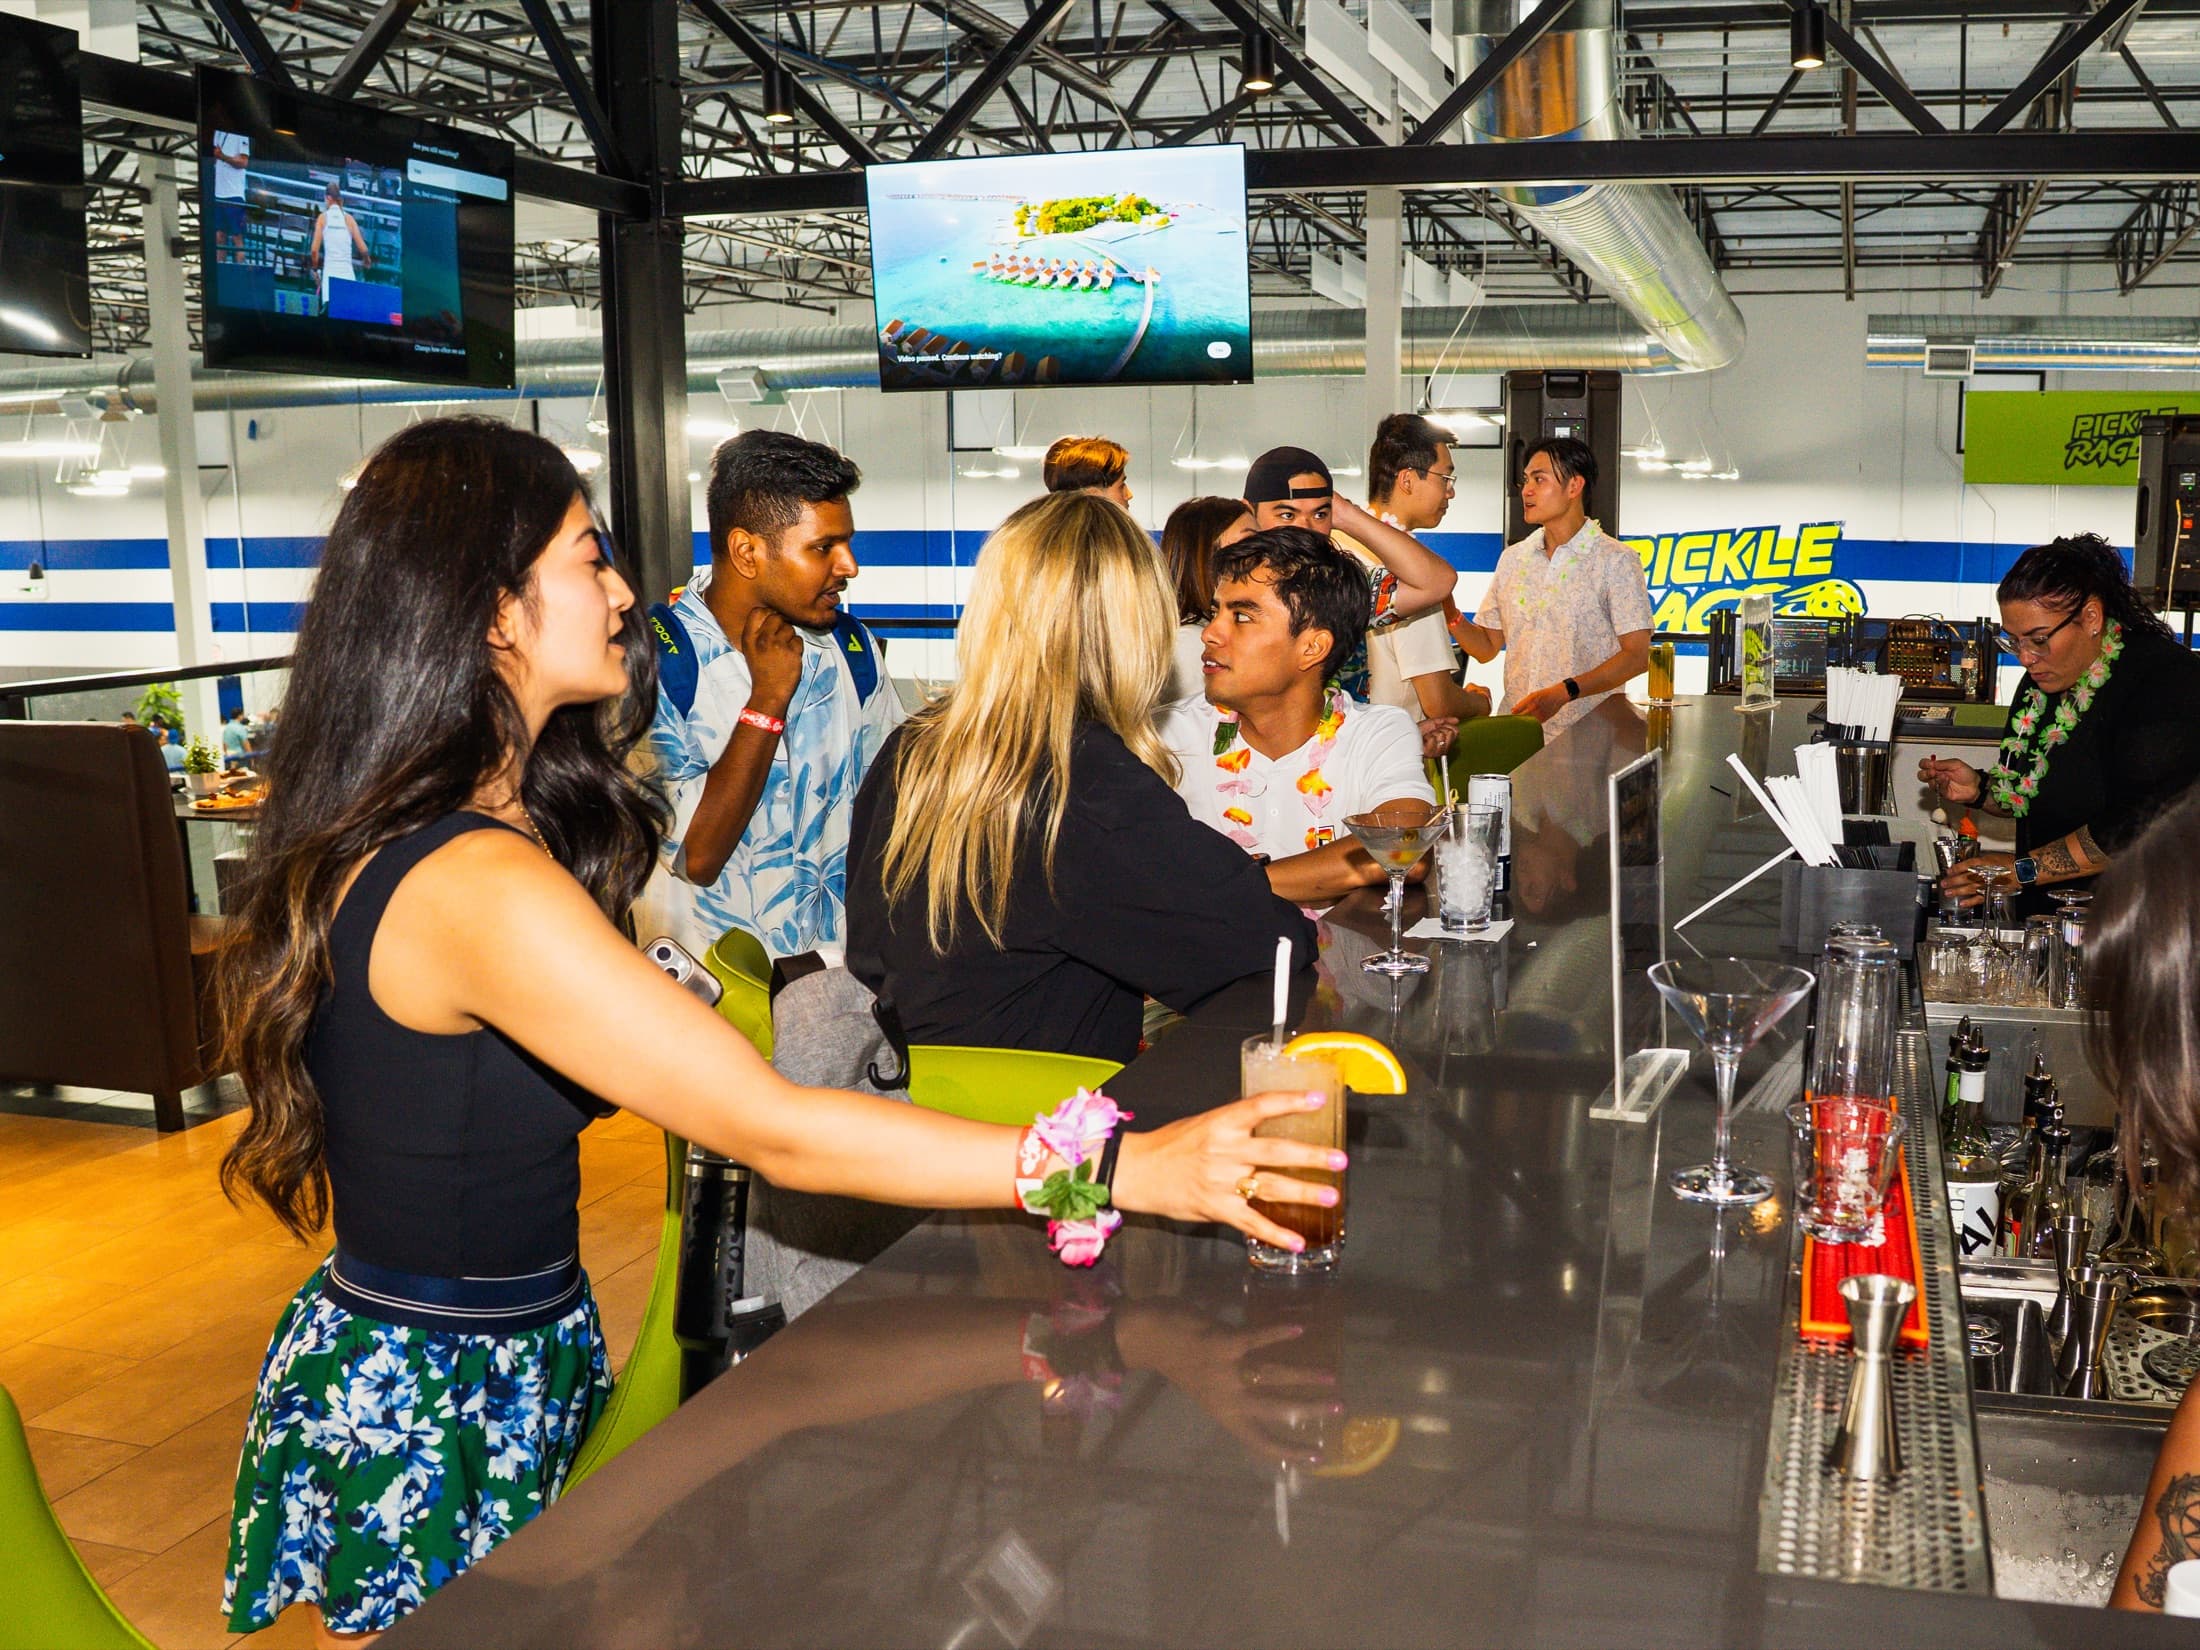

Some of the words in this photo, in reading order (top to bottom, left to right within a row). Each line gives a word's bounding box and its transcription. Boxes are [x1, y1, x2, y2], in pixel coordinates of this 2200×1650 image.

[916, 353, 940, 363] paused.
[941, 353, 970, 361] Continue
[970, 351, 1003, 361] watching?
